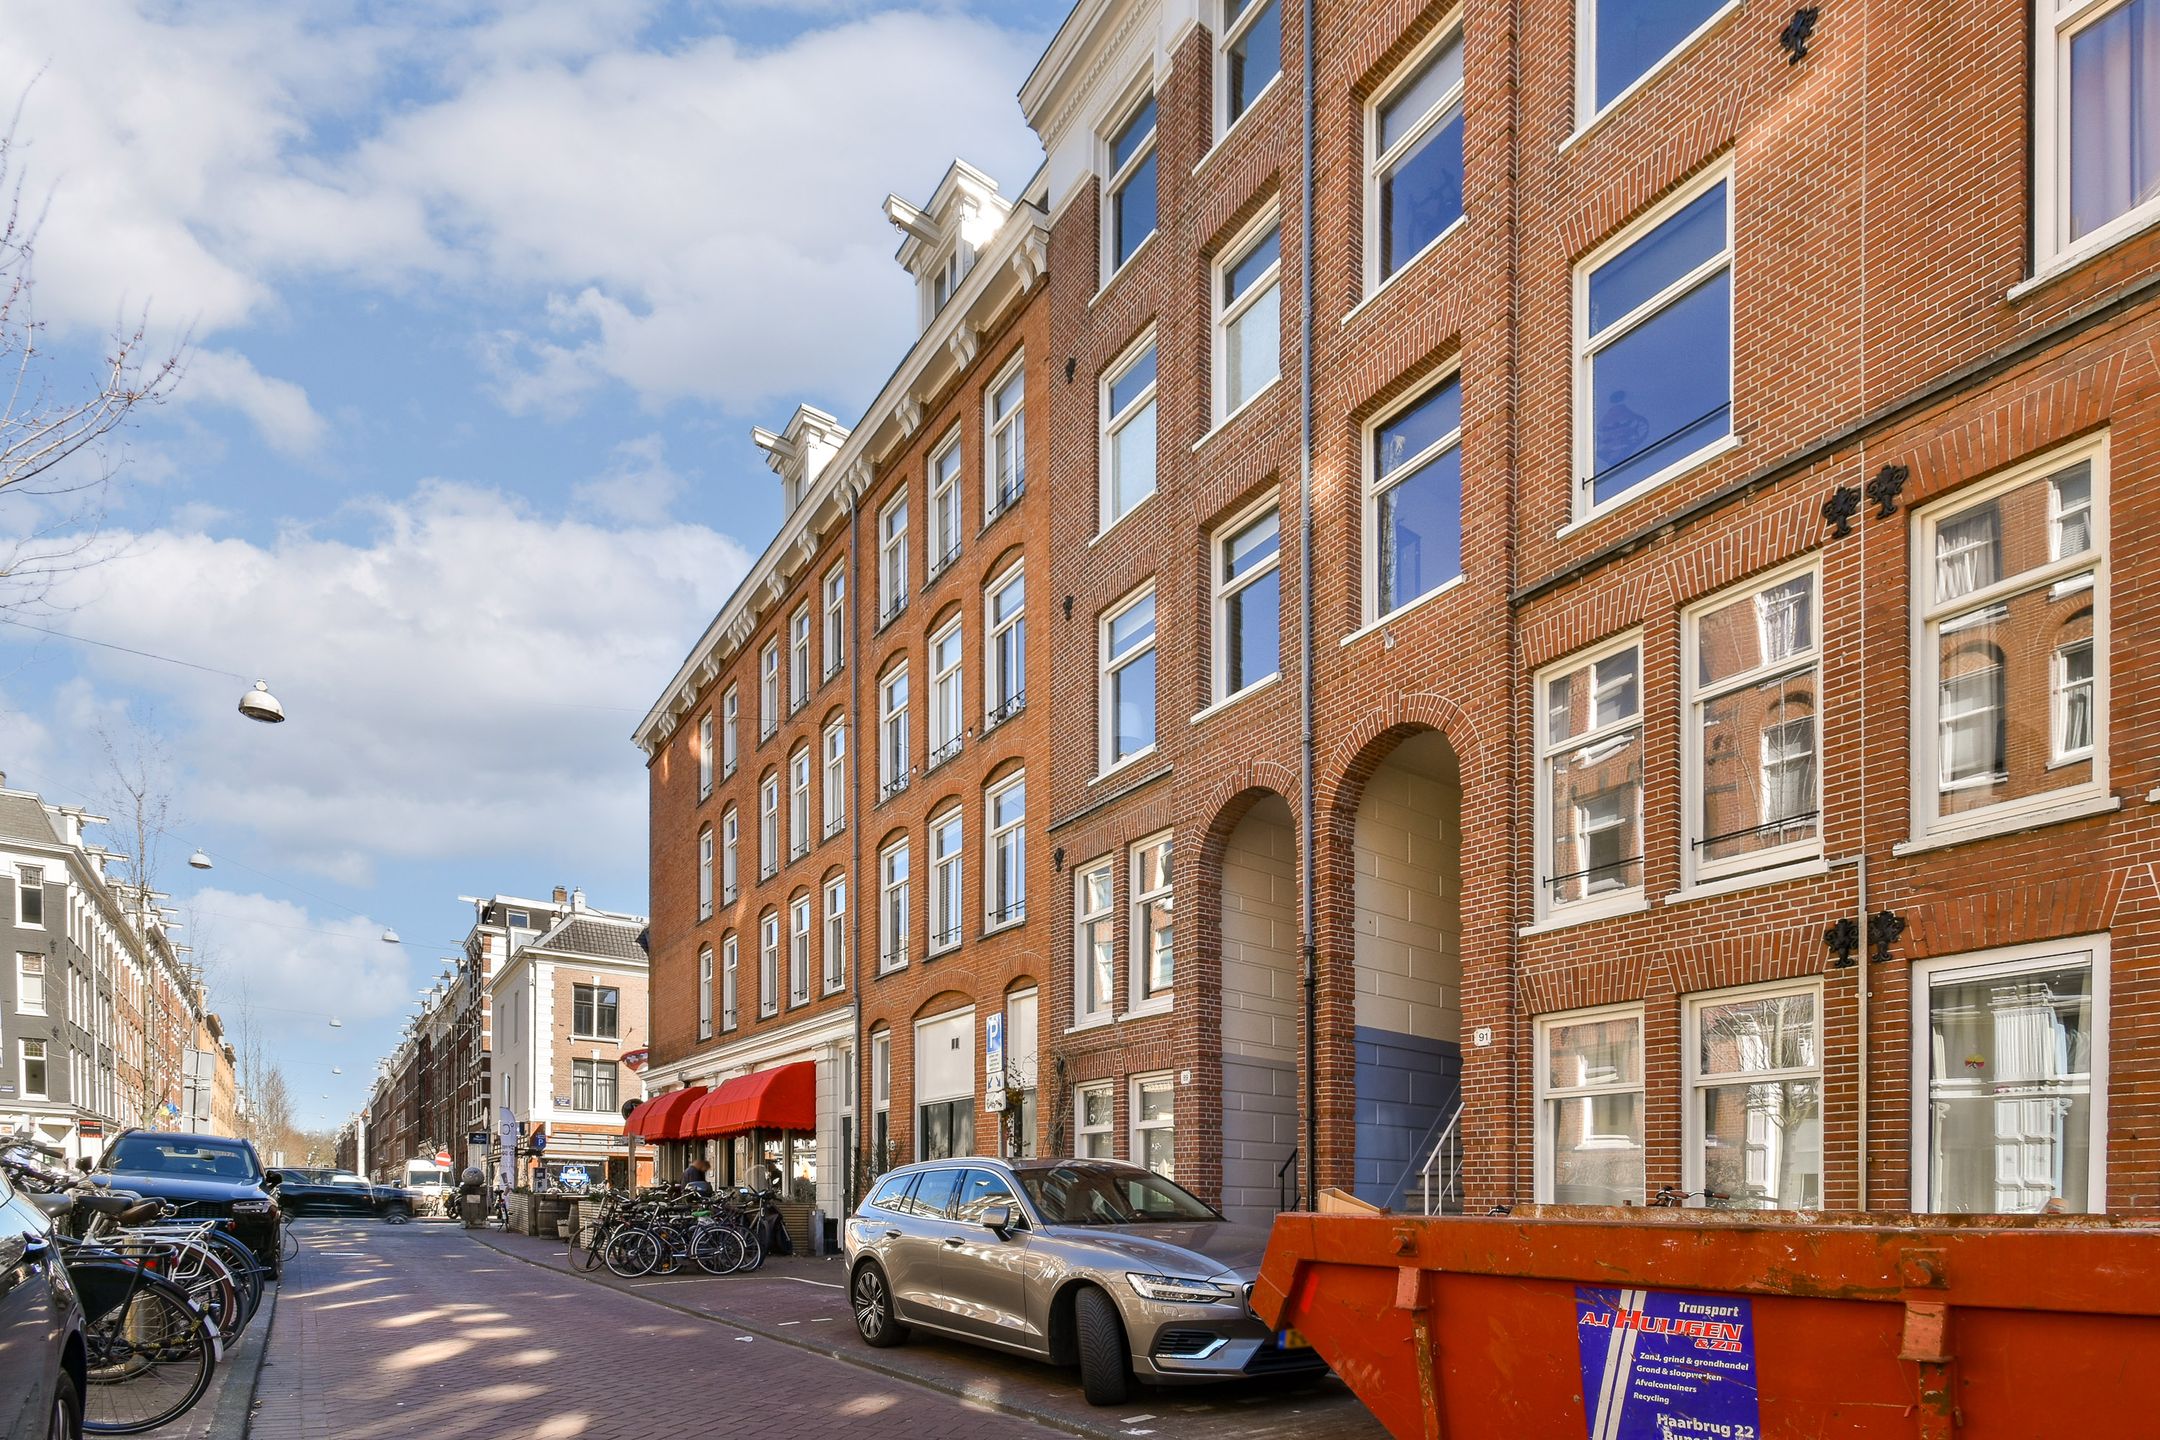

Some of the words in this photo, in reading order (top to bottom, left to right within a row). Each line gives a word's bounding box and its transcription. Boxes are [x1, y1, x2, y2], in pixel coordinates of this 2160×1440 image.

[989, 1020, 998, 1048] P
[1479, 1033, 1488, 1041] 91
[1679, 1302, 1739, 1318] Transport
[1579, 1311, 1611, 1328] AJ
[1636, 1365, 1661, 1375] Grond
[1662, 1367, 1669, 1375] &
[1663, 1355, 1685, 1364] grind
[1694, 1358, 1749, 1371] grondhandel
[1635, 1378, 1697, 1393] Afvalcontainers
[1633, 1391, 1670, 1405] Recycling
[1656, 1413, 1731, 1438] Haarbrug
[1734, 1424, 1755, 1438] 22
